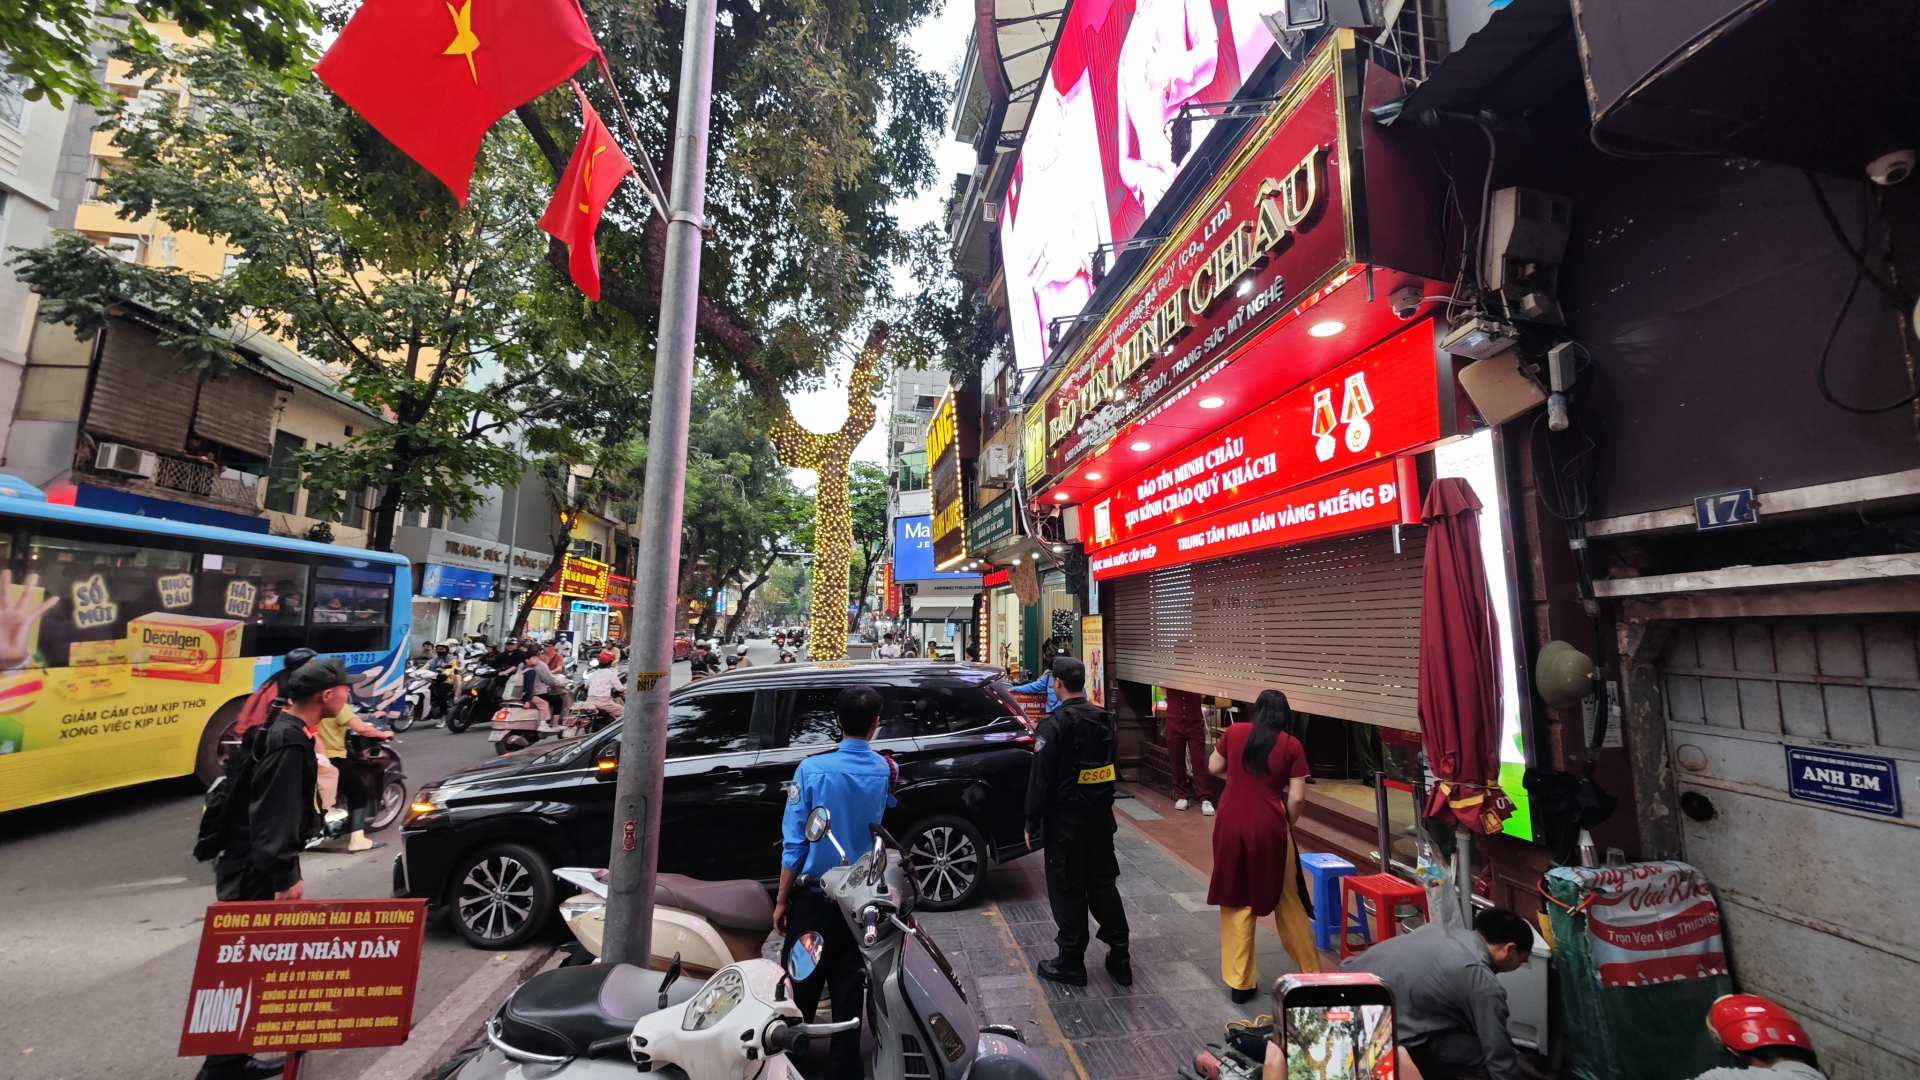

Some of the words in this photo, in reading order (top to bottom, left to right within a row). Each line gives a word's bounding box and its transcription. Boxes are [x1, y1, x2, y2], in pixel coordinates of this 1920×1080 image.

[1204, 201, 1232, 241] LTD)
[1049, 398, 1077, 448] BẢO
[1078, 361, 1109, 419] TÍN
[1110, 285, 1187, 391] MINH
[1189, 144, 1332, 314] CHÂU
[1171, 345, 1202, 378] TRANG
[1204, 326, 1226, 353] SỨC
[1227, 305, 1245, 335] MỸ
[1247, 275, 1284, 320] NGHỆ
[927, 402, 955, 470] VÀNG
[1137, 477, 1156, 500] BẢO
[1156, 469, 1173, 492] TÍN
[1174, 455, 1205, 484] MINH
[1205, 436, 1244, 469] CHÂU
[1124, 509, 1139, 527] XIN
[1139, 500, 1162, 522] KÍNH
[1162, 487, 1193, 513] CHÀO
[1194, 472, 1220, 504] QUÝ
[1221, 452, 1278, 491] KHÁCH
[1103, 554, 1113, 570] NHÀ
[1113, 550, 1129, 567] NƯỚC
[1128, 547, 1140, 563] CẤP
[1140, 543, 1157, 560] PHÉP
[1177, 533, 1205, 551] TRUNG
[1205, 525, 1226, 545] TÂM
[1226, 521, 1251, 540] MUA
[1251, 511, 1276, 534] BÁN
[1277, 503, 1316, 528] VÀNG
[1318, 488, 1375, 518] MIẾNG
[445, 540, 482, 559] TRANG
[483, 546, 503, 563] SỨC
[513, 551, 538, 569] ĐỒNG
[142, 628, 201, 650] Decolgen
[159, 649, 182, 658] FORTE
[59, 722, 98, 740] XONG
[103, 718, 131, 735] VIỆC
[134, 716, 154, 730] KỊP
[156, 711, 180, 726] LÚC
[62, 708, 97, 725] GIẢM
[100, 704, 129, 720] CẢM
[132, 701, 158, 716] CÚM
[160, 701, 180, 713] KỊP
[183, 697, 207, 709] THỜI
[1082, 768, 1112, 781] CSCĐ
[1802, 766, 1845, 786] ANH
[1850, 773, 1881, 791] EM
[213, 913, 250, 928] CÔNG
[252, 913, 271, 927] AN
[274, 910, 327, 926] PHƯỜNG
[329, 911, 351, 925] HAI
[354, 911, 372, 924] BÀ
[375, 910, 415, 924] TRƯNG
[1607, 930, 1632, 946] Trọn
[1632, 932, 1655, 946] Vẹn
[1656, 927, 1677, 942] Yêu
[1677, 912, 1720, 936] Thương
[217, 936, 245, 964] ĐỀ
[248, 942, 298, 966] NGHỊ
[301, 936, 355, 960] NHÂN
[358, 935, 401, 959] DÂN
[307, 969, 325, 981] TRÊN
[189, 980, 243, 1034] KHÔNG
[262, 989, 287, 1001] KHÔNG
[298, 989, 308, 999] XE
[308, 988, 324, 999] MÁY
[325, 987, 343, 998] TRÊN
[367, 985, 385, 997] DƯỚI
[385, 984, 403, 996] LÒNG
[285, 1003, 298, 1014] SAI
[299, 1002, 314, 1014] QUY
[256, 1020, 281, 1032] KHÔNG
[281, 1018, 295, 1031] XẾP
[296, 1019, 316, 1031] HÀNG
[355, 1016, 374, 1028] LÒNG
[374, 1015, 399, 1027] ĐƯỜNG
[253, 1033, 268, 1046] GÂY
[300, 1033, 318, 1043] GIAO
[319, 1031, 342, 1042] THÔNG
